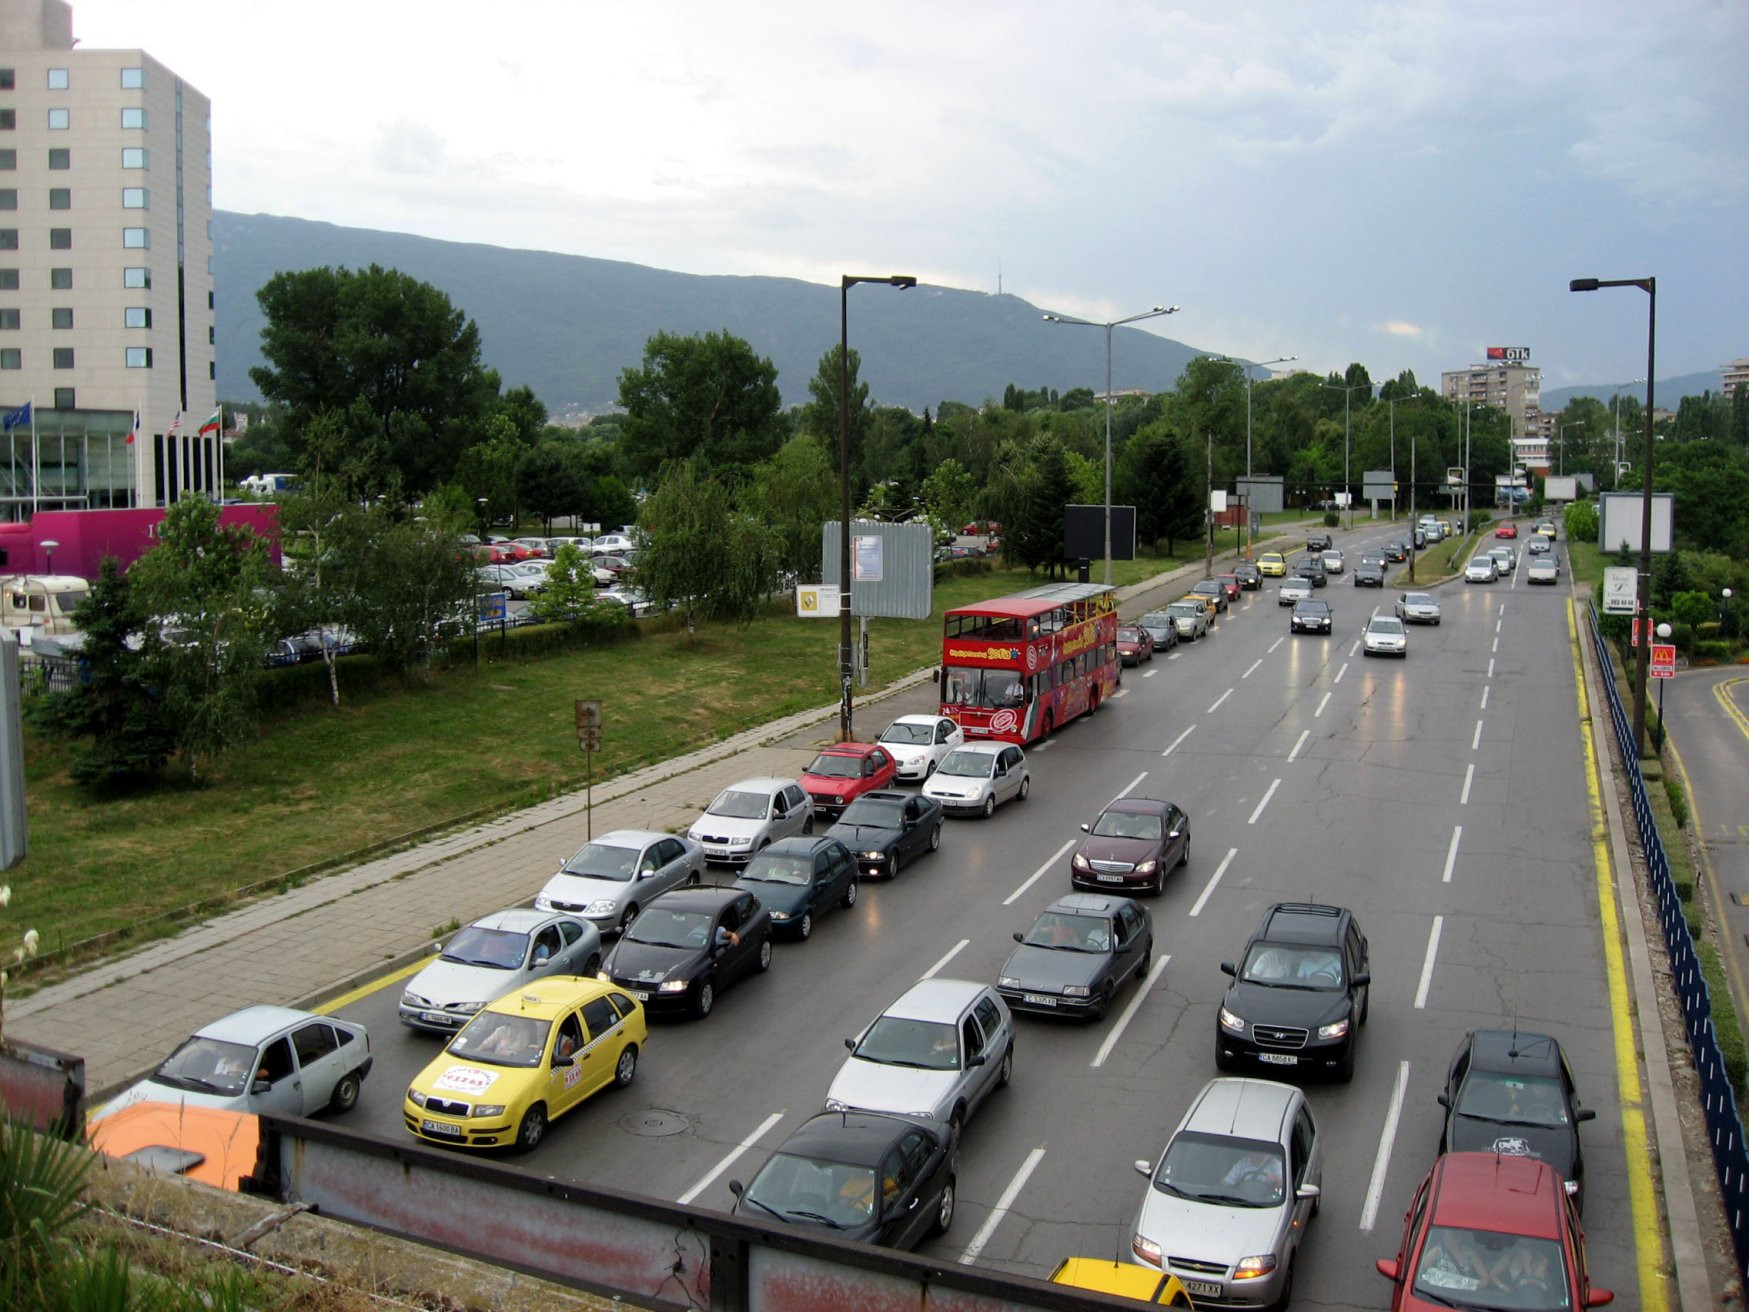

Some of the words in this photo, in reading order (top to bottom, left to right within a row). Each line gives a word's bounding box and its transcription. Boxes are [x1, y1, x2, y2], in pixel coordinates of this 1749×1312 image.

[988, 648, 1011, 660] Sofia
[427, 1121, 435, 1130] CA
[436, 1123, 450, 1133] 1600
[451, 1126, 459, 1134] BA
[1187, 1281, 1206, 1292] 4271
[1208, 1284, 1219, 1295] XX
